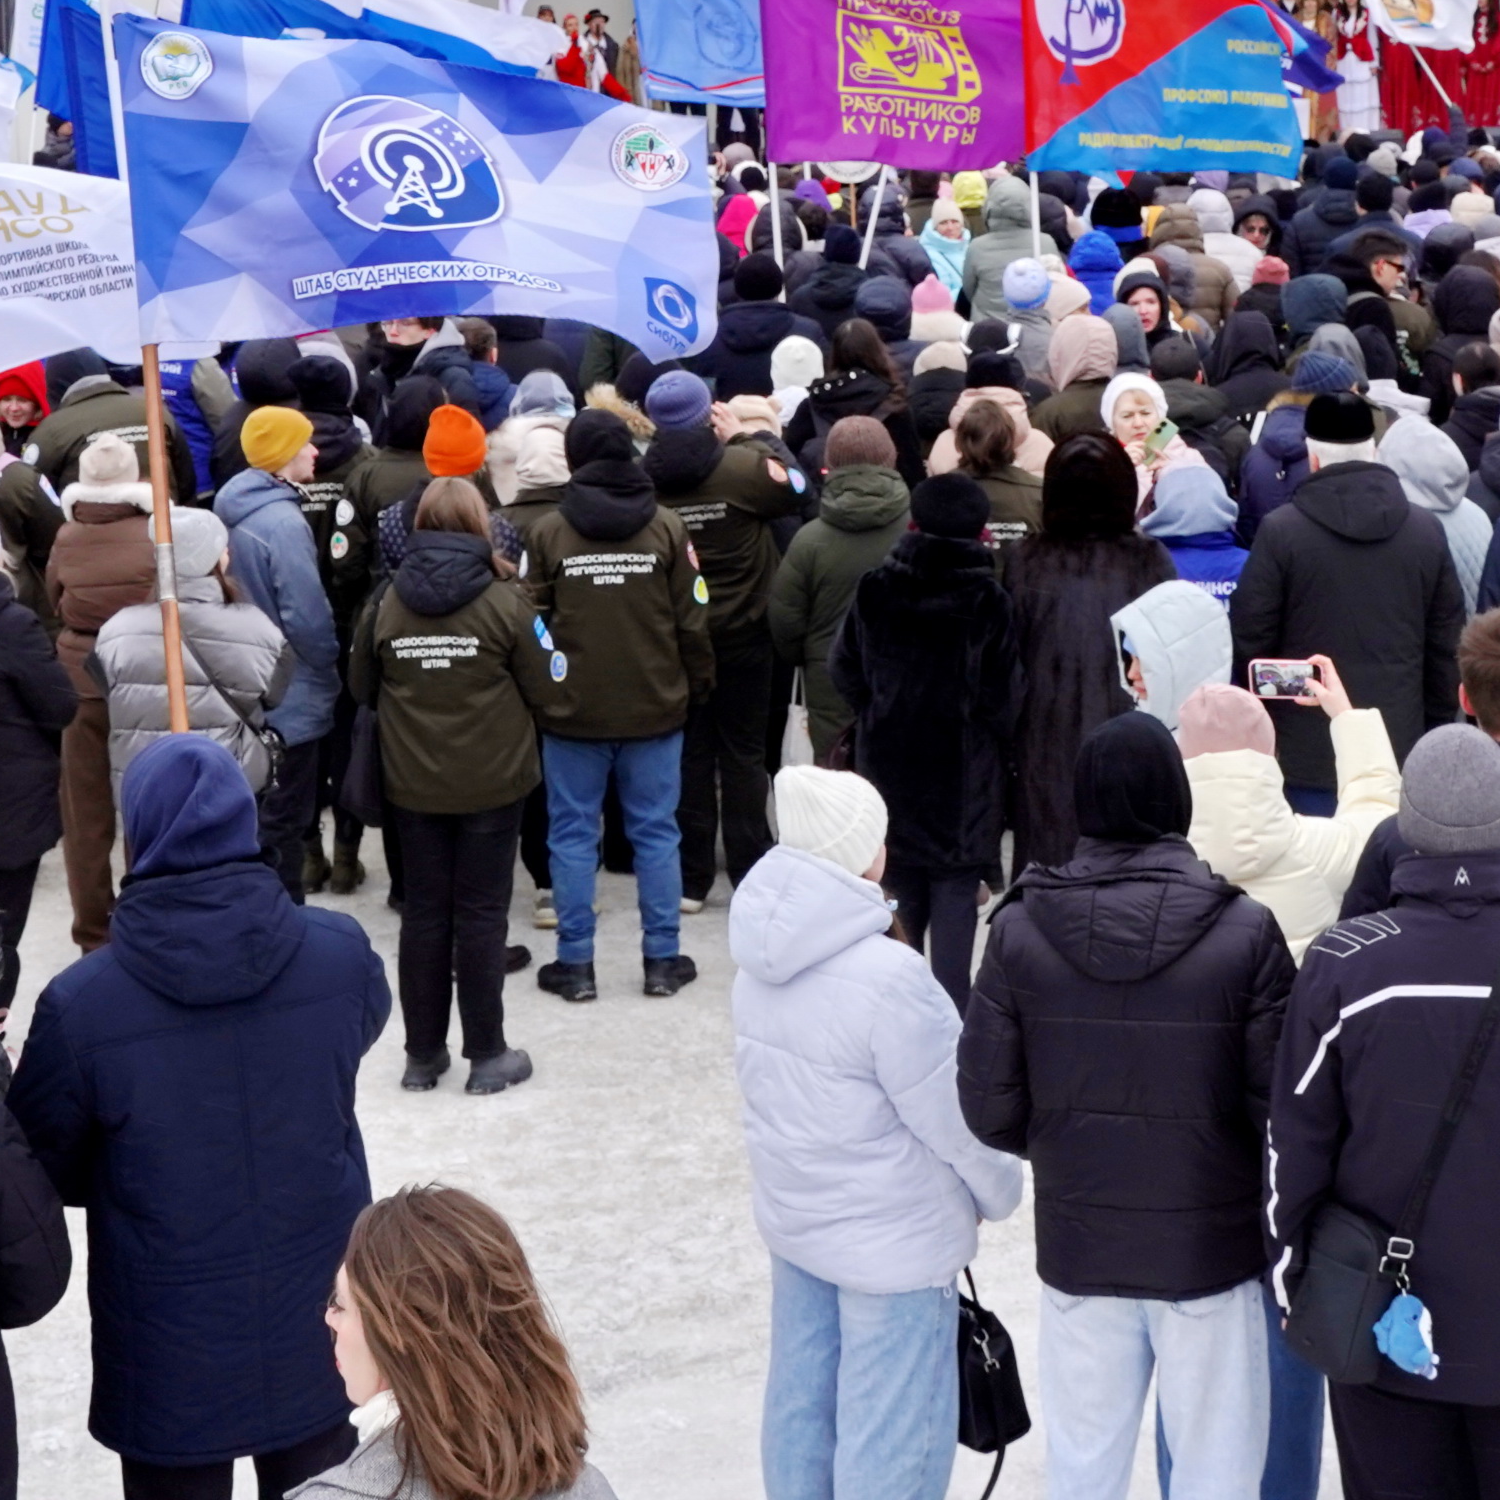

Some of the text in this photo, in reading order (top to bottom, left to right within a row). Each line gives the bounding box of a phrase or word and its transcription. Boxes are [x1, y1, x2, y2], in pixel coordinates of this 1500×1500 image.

[839, 94, 982, 125] РАБОТНИКОВ
[842, 115, 978, 146] КУЛЬТУРЫ
[11, 266, 104, 296] ХУДОЖЕСТВЕННОЙ
[294, 263, 560, 297] ШТАБ СТУДЕНЧЕСКИХ ОТРЯДОВ
[89, 278, 134, 297] ОБЛАСТИ
[563, 554, 657, 568] НОВОСИБИРСКИЙ
[565, 564, 653, 577] РЕГИОНАЛЬНЫЙ
[593, 575, 625, 585] ШТАБ
[391, 636, 479, 649] НОВОСИБИРСКИЙ
[396, 646, 477, 659] РЕГИОНАЛЬНЫЙ
[421, 658, 451, 669] ШТАБ
